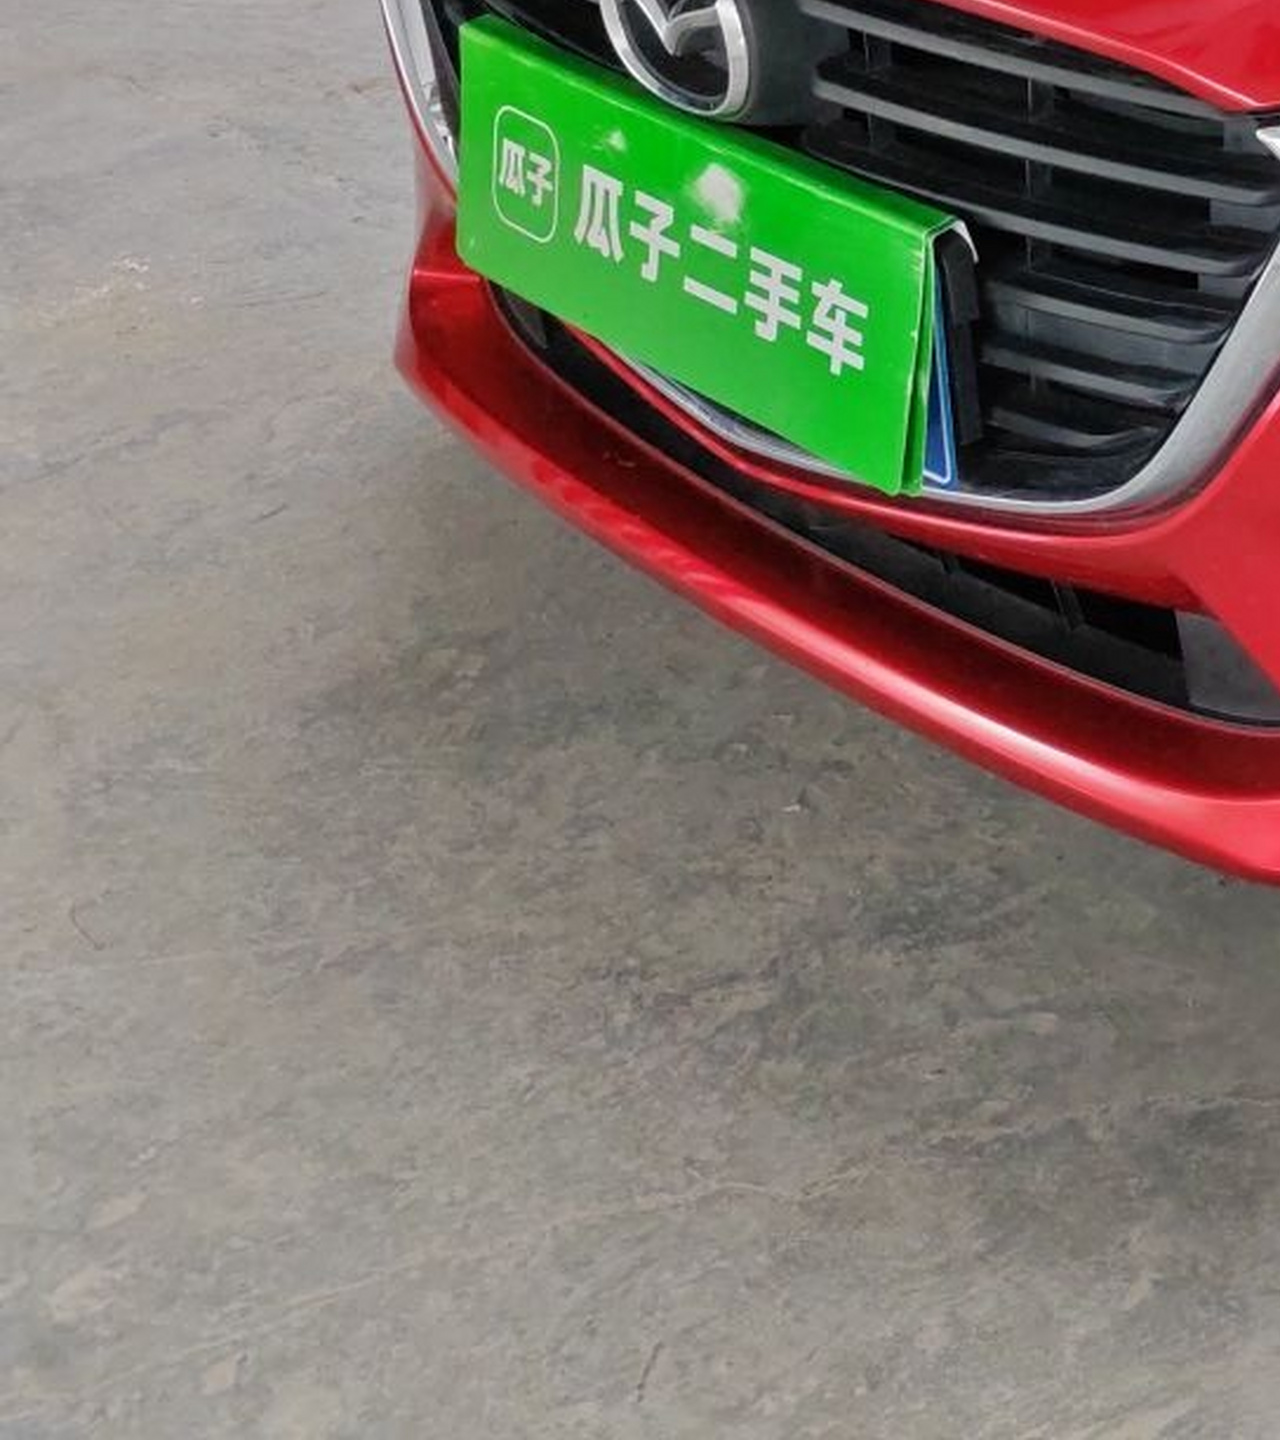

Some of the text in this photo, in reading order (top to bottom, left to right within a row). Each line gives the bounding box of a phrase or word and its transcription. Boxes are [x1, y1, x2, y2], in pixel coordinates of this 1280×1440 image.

[498, 138, 553, 206] 瓜子
[574, 164, 868, 376] 瓜子二手车
